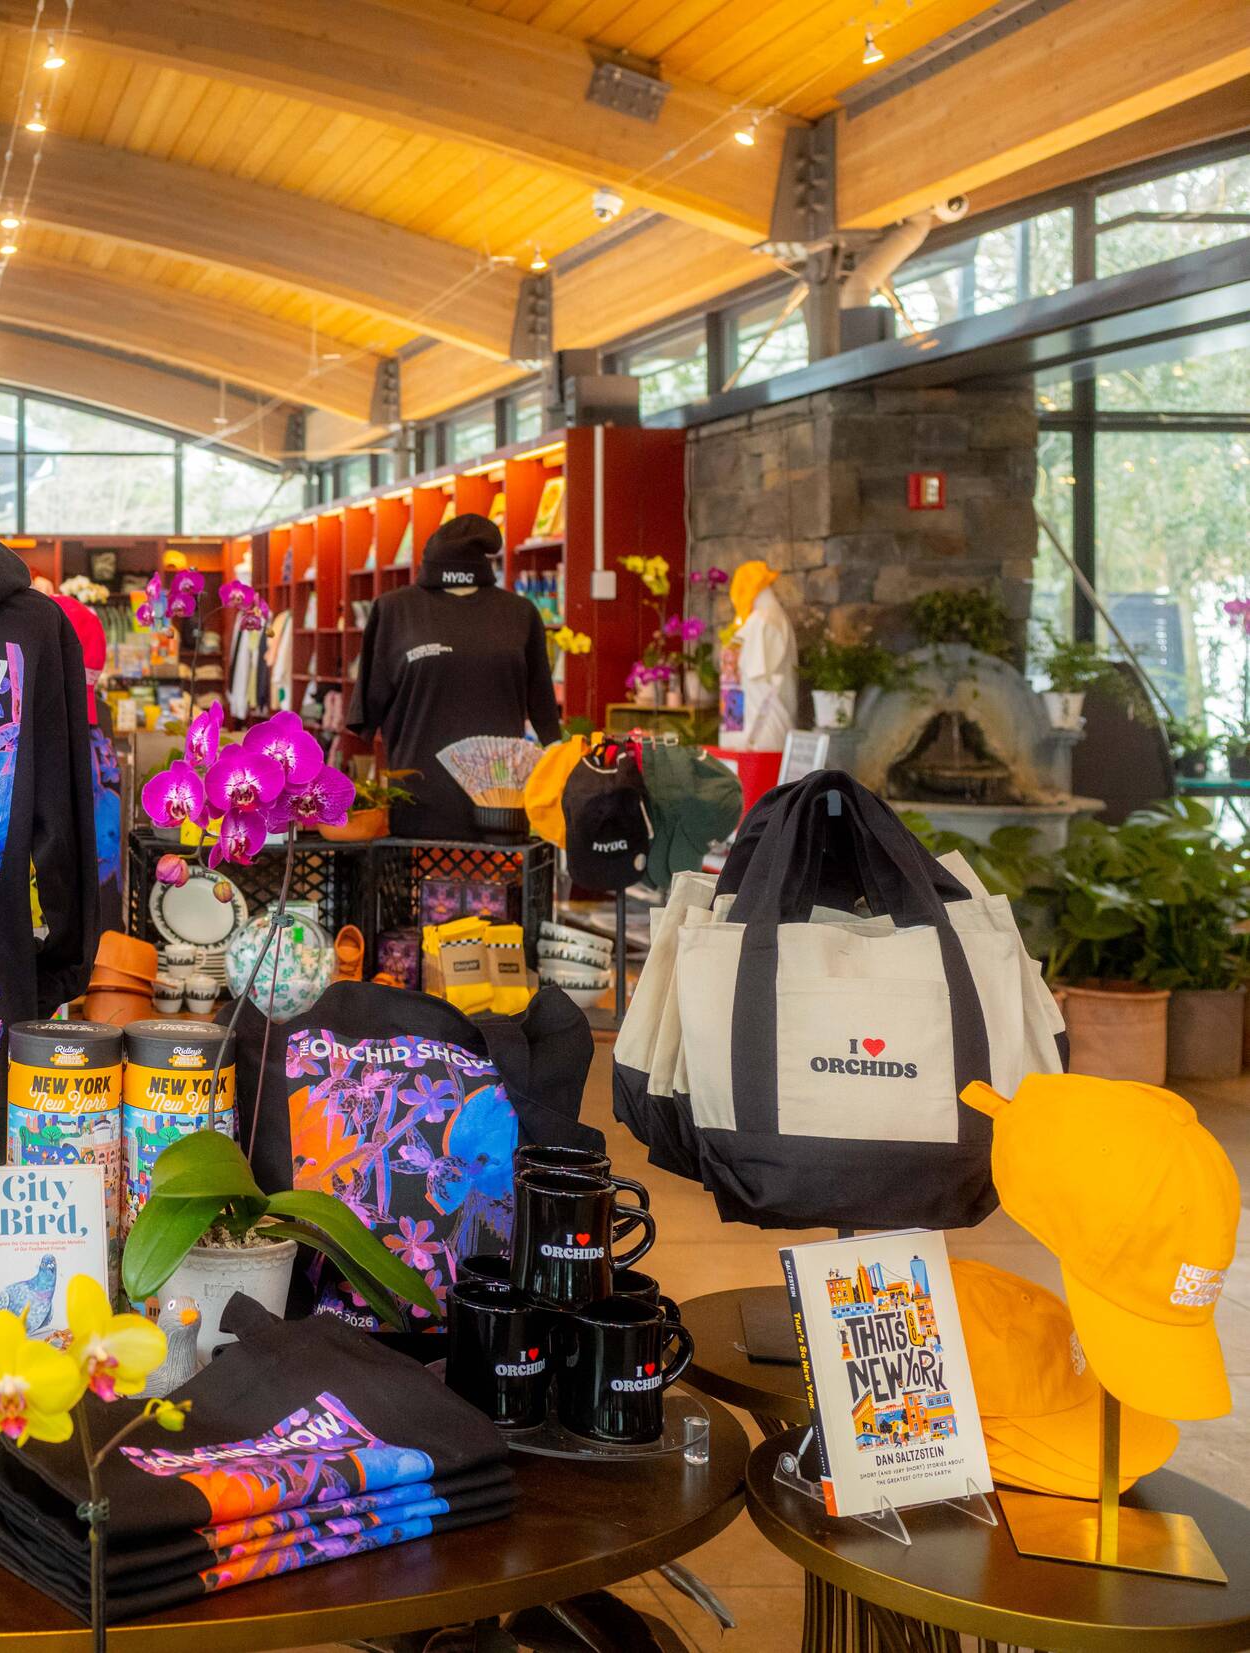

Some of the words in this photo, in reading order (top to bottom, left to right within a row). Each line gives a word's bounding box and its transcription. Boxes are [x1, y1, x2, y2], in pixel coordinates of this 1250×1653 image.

[442, 571, 475, 584] NYBG
[592, 840, 628, 852] NYBG
[54, 1045, 85, 1055] Ridley's
[173, 1047, 203, 1057] Ridley's
[299, 1040, 310, 1057] THE
[310, 1039, 412, 1064] ORCHID
[416, 1043, 494, 1070] SHOW
[849, 1039, 859, 1054] I
[810, 1056, 918, 1079] ORCHIDS
[32, 1075, 68, 1094] NEW
[74, 1075, 111, 1094] YORK
[149, 1076, 183, 1096] NEW
[30, 1088, 66, 1113] New
[68, 1088, 108, 1117] York
[146, 1087, 182, 1113] New
[2, 1172, 74, 1209] City
[566, 1234, 573, 1245] I
[540, 1244, 604, 1259] ORCHIDS
[845, 1311, 908, 1358] THAT'S
[520, 1350, 526, 1362] I
[793, 1312, 805, 1343] THAT'S
[806, 1384, 816, 1410] YORK
[636, 1366, 643, 1377] I
[846, 1354, 904, 1403] NEW
[902, 1347, 947, 1392] YORK
[157, 1448, 259, 1468] ORCHID
[256, 1411, 344, 1453] SHOW
[876, 1454, 894, 1466] DAN
[896, 1446, 945, 1464] SALTZSTEIN
